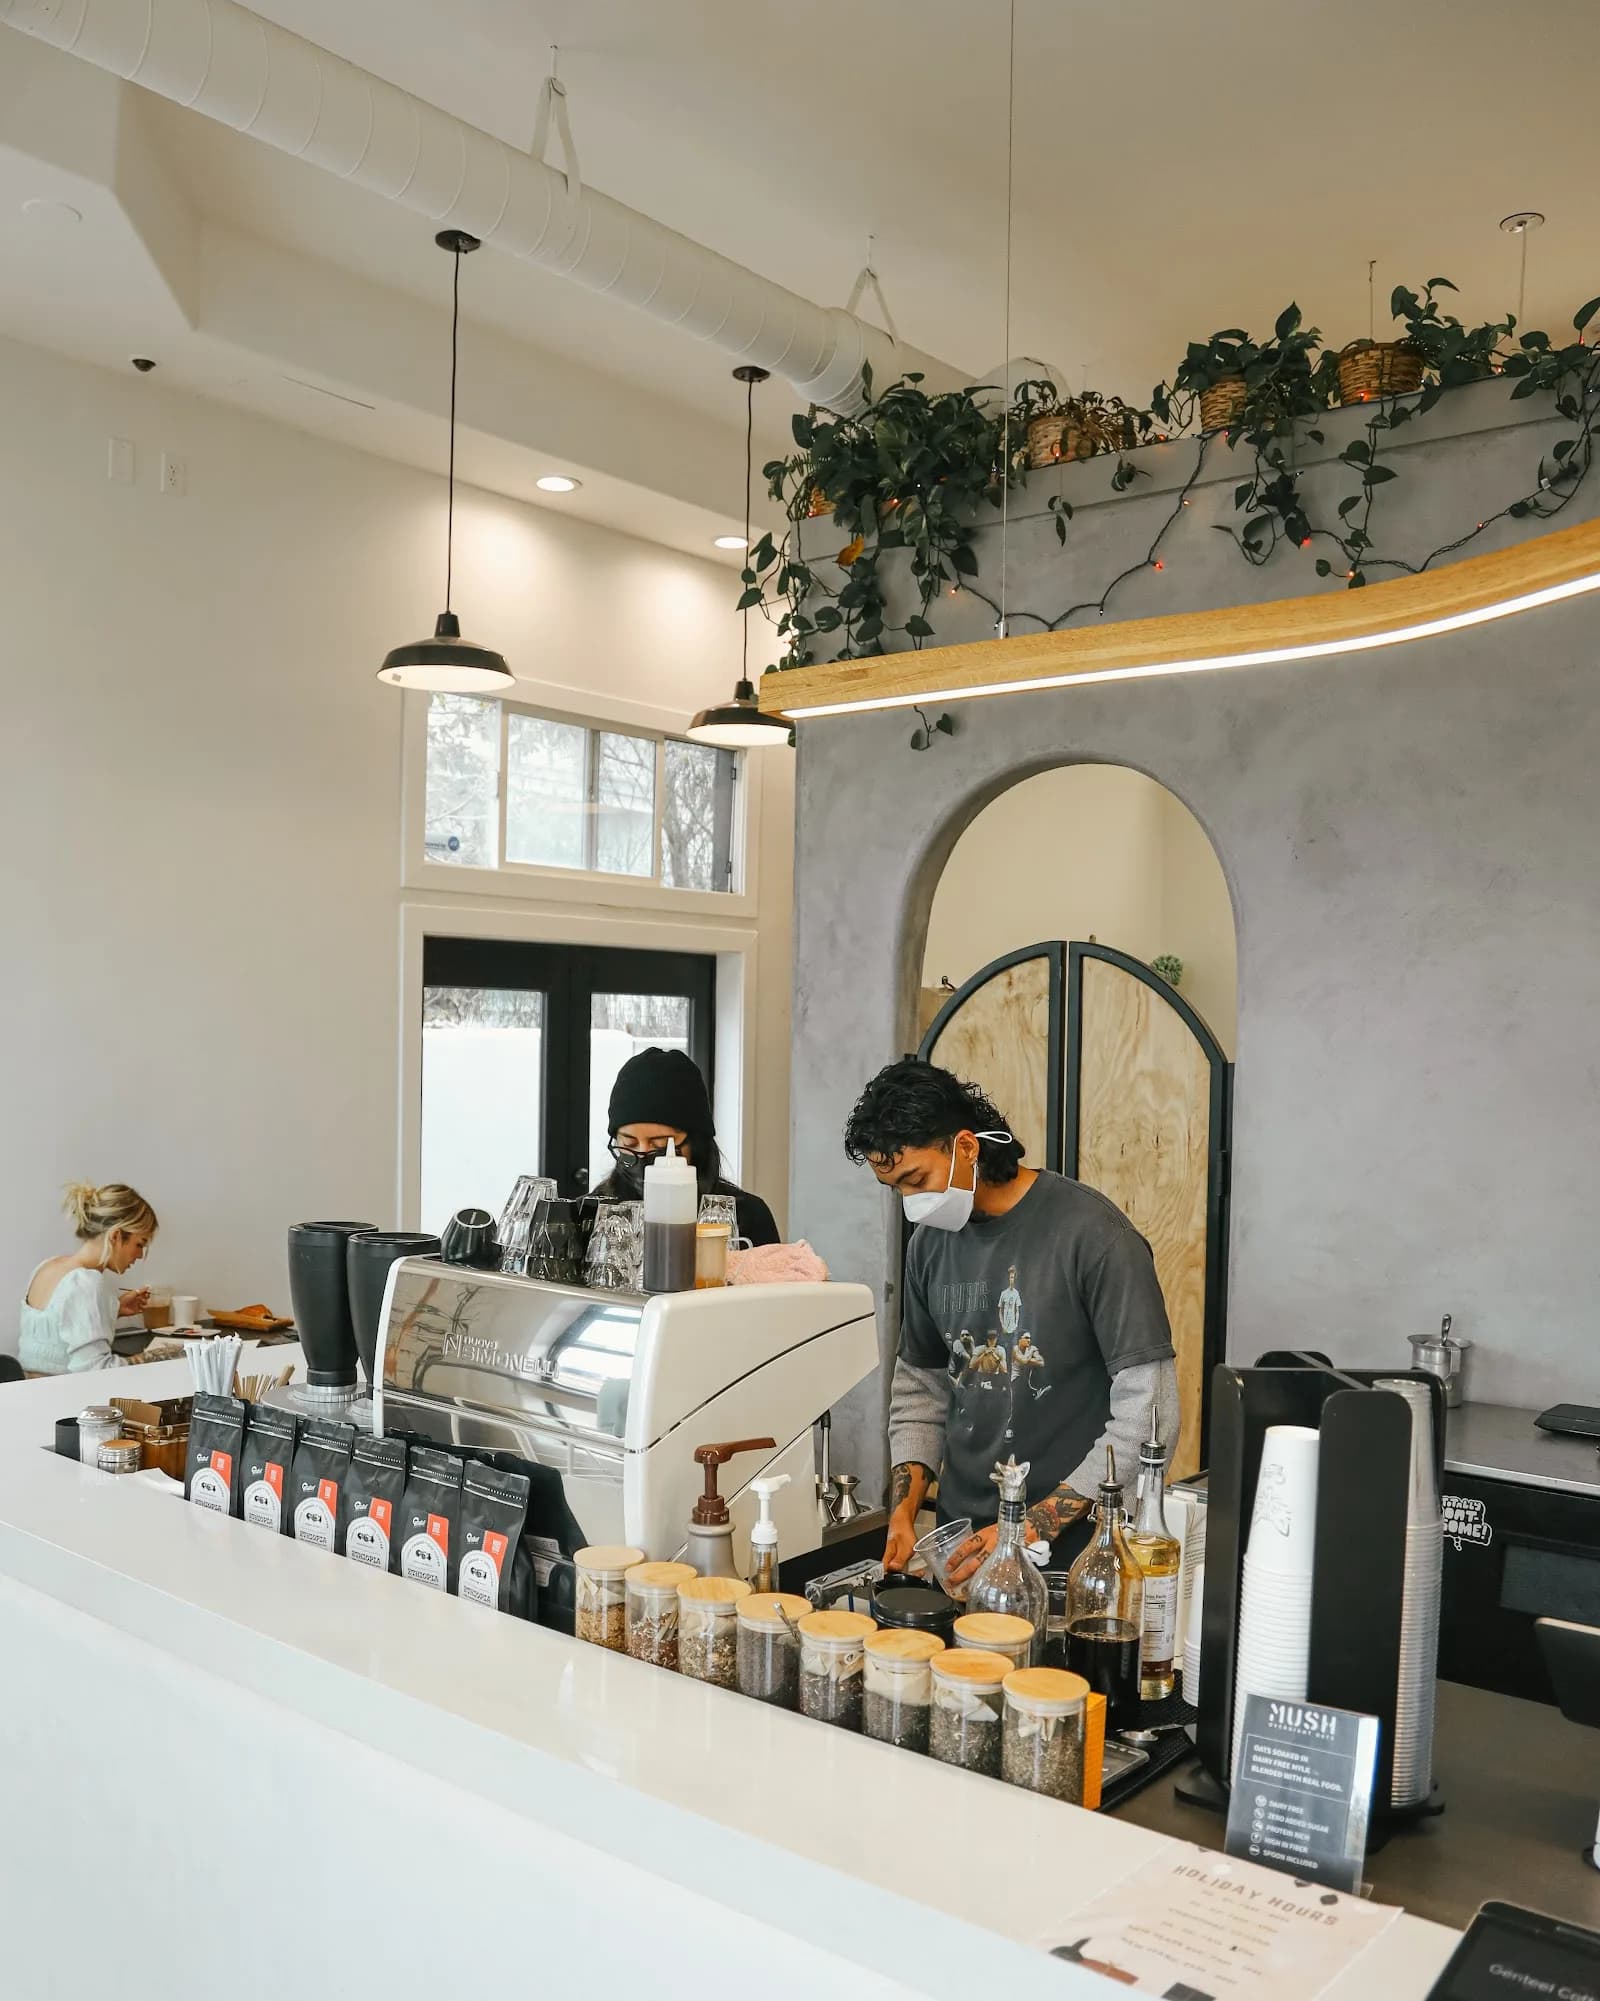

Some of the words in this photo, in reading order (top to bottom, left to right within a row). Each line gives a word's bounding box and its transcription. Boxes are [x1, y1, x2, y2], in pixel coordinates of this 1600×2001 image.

[1269, 1703, 1336, 1734] MUSH
[1283, 1772, 1301, 1783] WITH
[1172, 1865, 1262, 1899] HOLIDAY
[1267, 1896, 1339, 1926] HOURS
